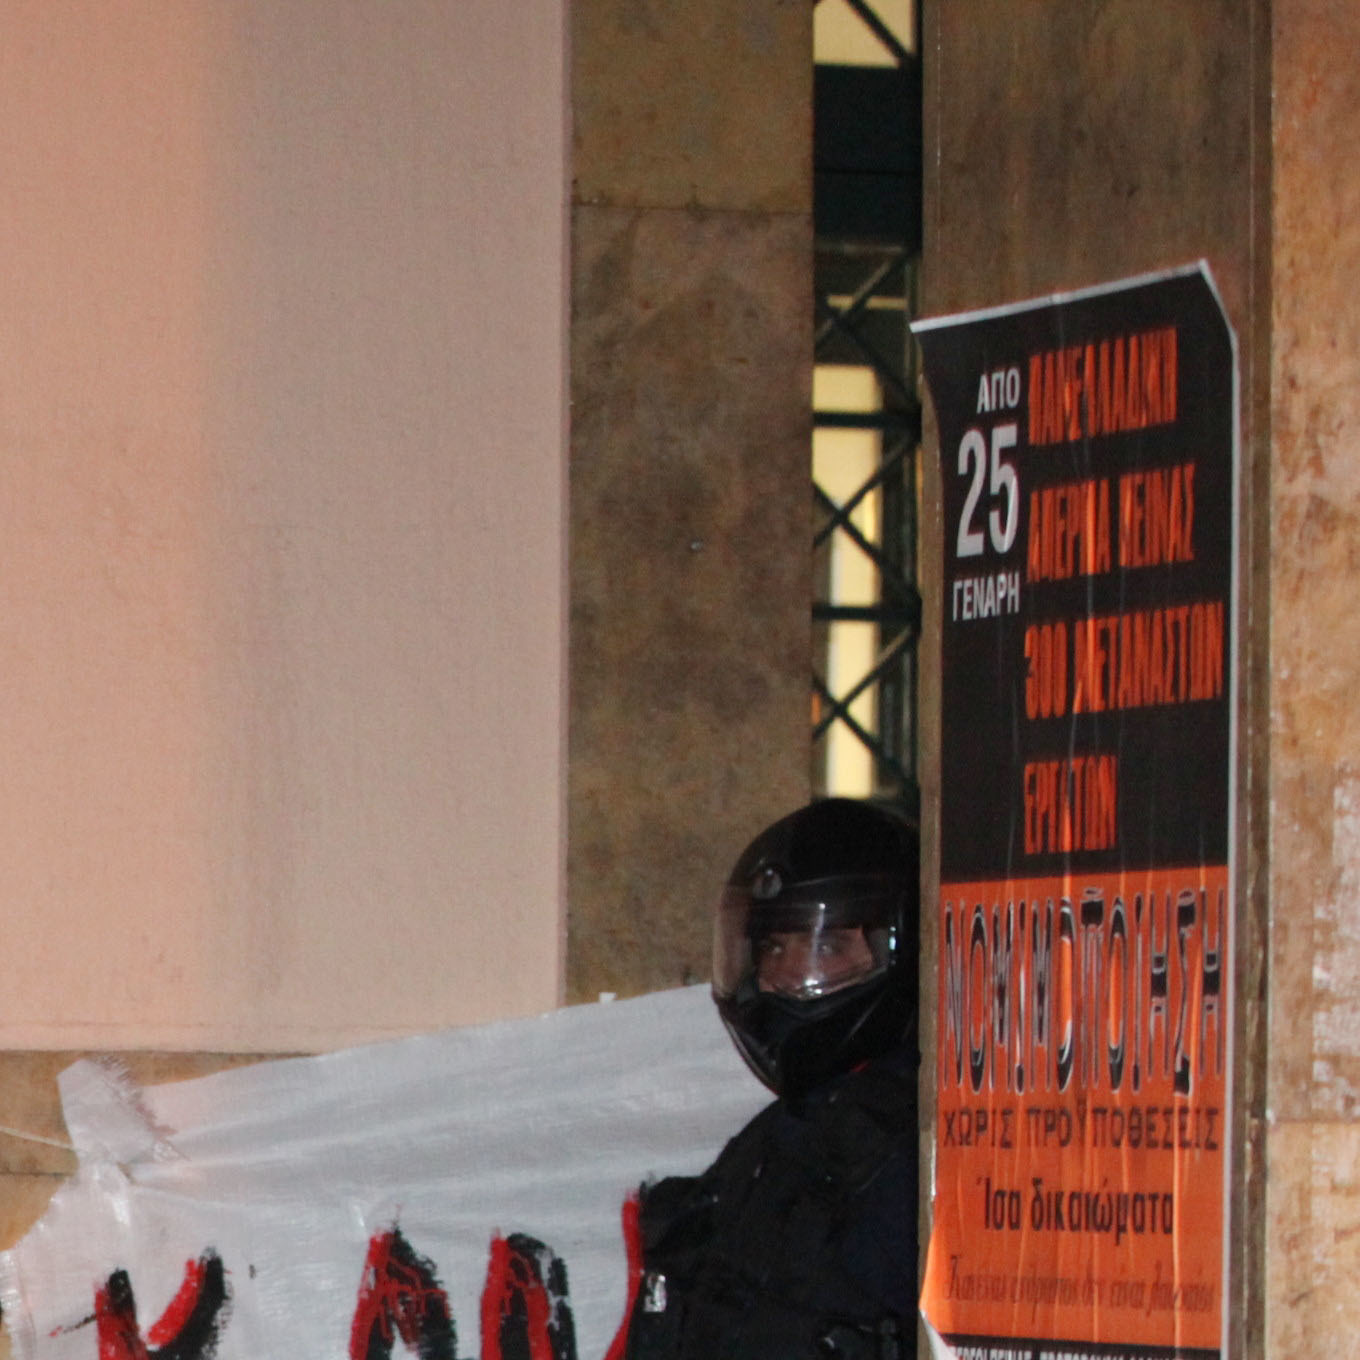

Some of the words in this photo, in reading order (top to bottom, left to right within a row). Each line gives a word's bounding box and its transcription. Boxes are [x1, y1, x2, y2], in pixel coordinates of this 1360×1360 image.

[976, 367, 1020, 413] ΑΠΟ
[956, 424, 1019, 558] 25
[1118, 462, 1195, 567] ΠΕΙΝΑΣ
[953, 572, 1020, 622] ΓΕΝΑΡΗ
[1024, 622, 1068, 720] 300
[1073, 602, 1224, 714] ΜΕΤΑΝΑΣΤΩΝ
[1023, 755, 1117, 855] ΕΡΓΑΤΩΝ
[943, 884, 1224, 1097] ΝΟΜΙΜΟΠΟΙΗΣΗ
[942, 1106, 1014, 1149] ΧΩΡΙΣ
[976, 1176, 1022, 1231] Ίσα
[1031, 1176, 1174, 1246] δικαιώματα
